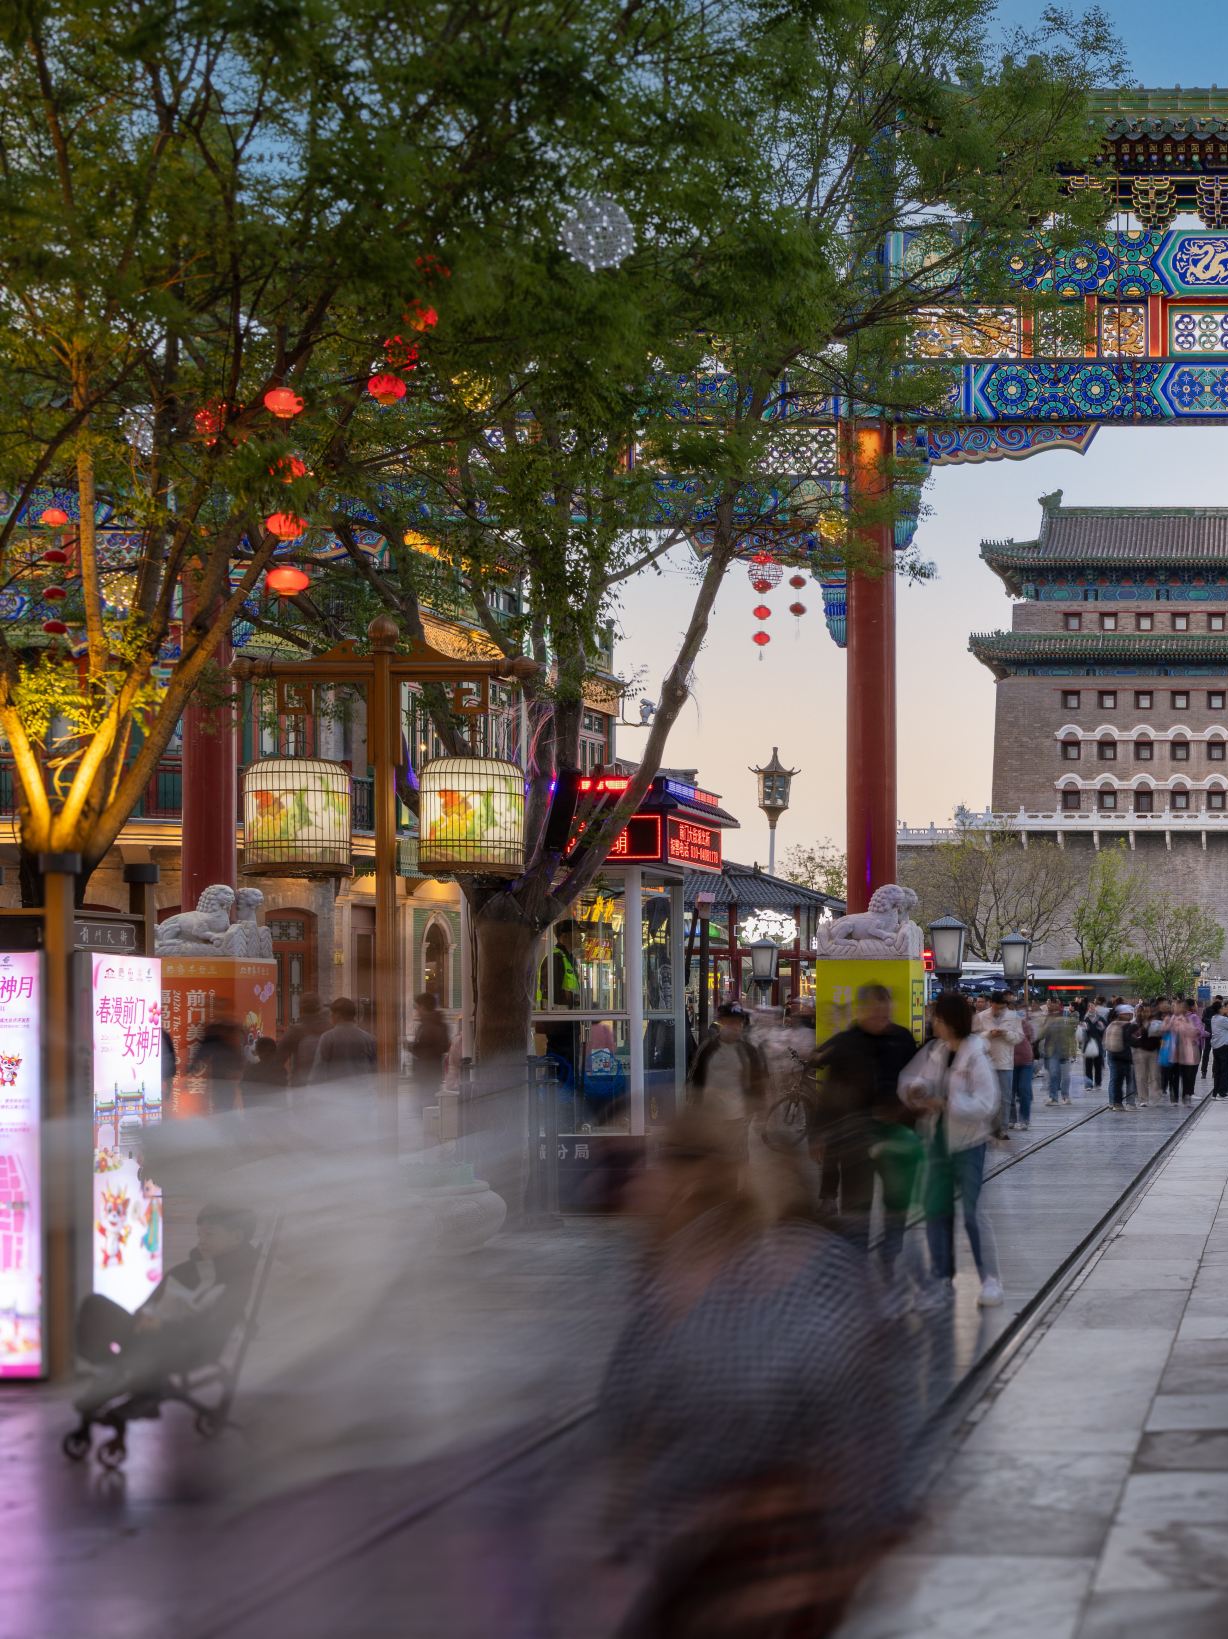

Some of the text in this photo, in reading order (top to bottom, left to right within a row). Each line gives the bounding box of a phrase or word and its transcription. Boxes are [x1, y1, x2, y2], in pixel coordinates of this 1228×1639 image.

[96, 996, 146, 1028] 春漫前门
[122, 1025, 161, 1064] 女神月
